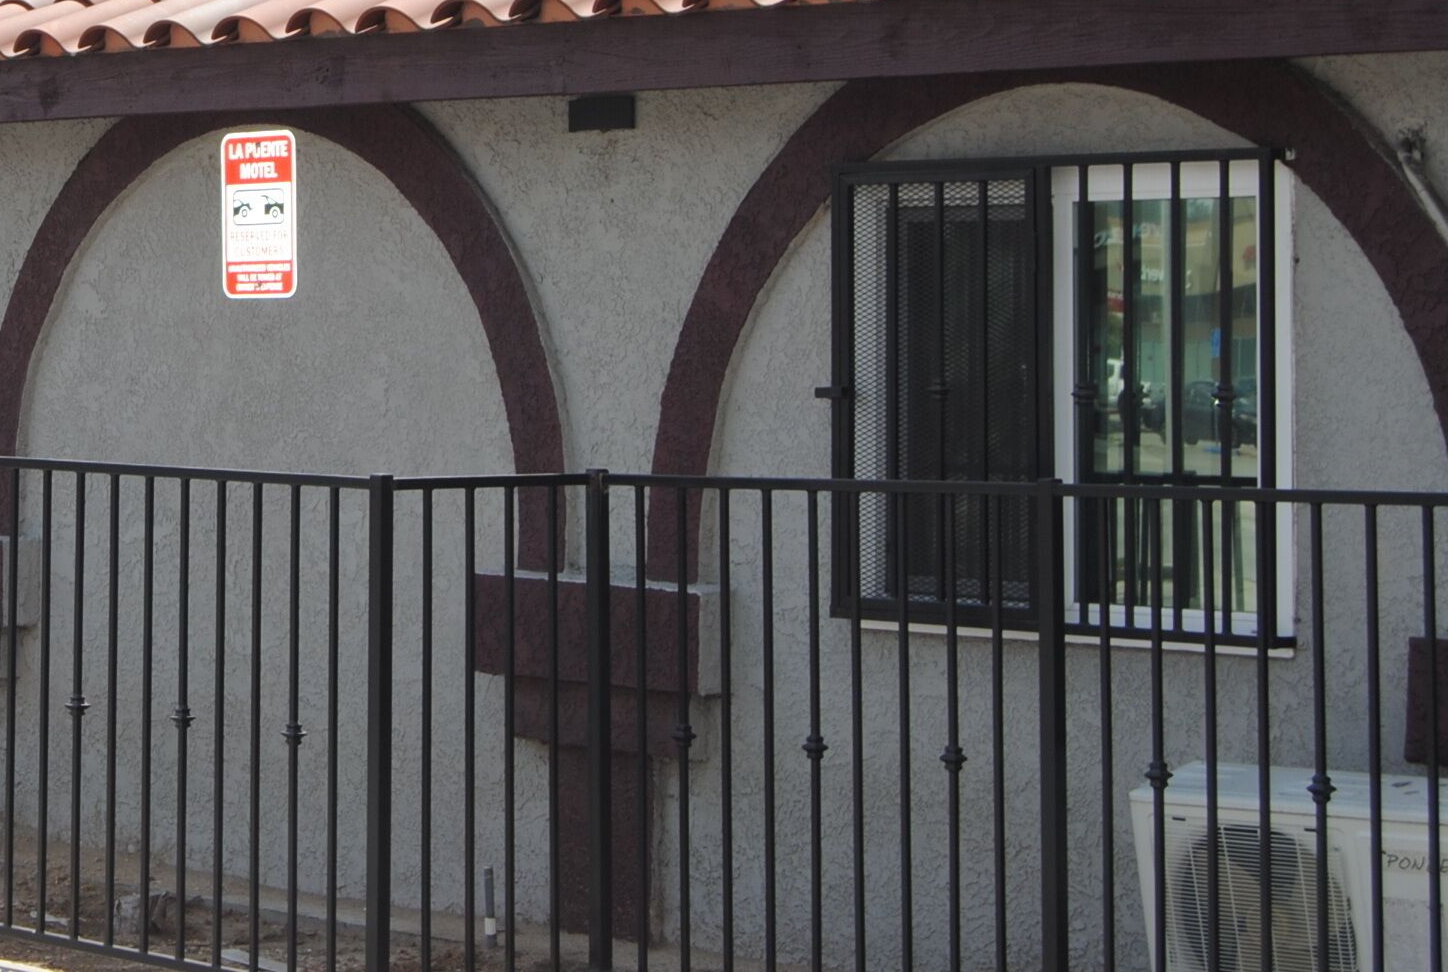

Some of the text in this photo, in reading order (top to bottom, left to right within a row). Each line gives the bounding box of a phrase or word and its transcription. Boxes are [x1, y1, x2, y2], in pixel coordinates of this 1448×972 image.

[229, 140, 289, 160] LA PUENTE
[239, 161, 279, 179] MOTEL
